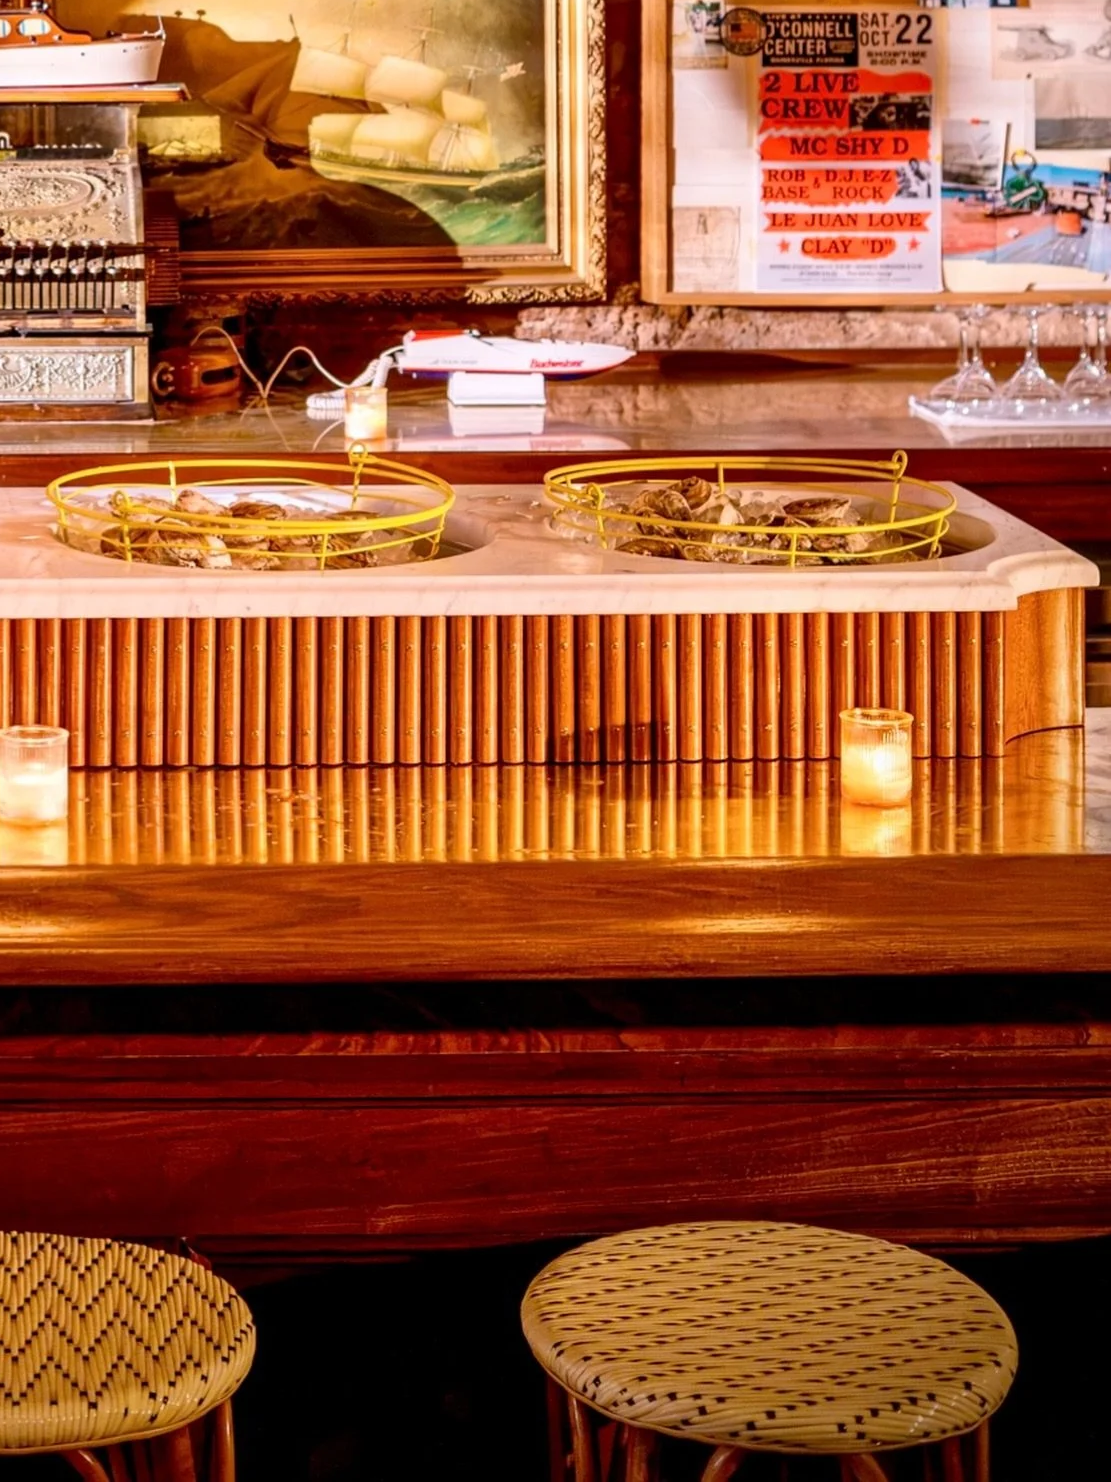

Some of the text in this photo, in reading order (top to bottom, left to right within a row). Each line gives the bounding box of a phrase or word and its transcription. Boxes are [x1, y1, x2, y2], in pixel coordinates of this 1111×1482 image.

[860, 13, 895, 28] SAT.
[895, 13, 933, 44] 22
[860, 31, 895, 46] OCT.
[764, 39, 827, 56] CENTER
[764, 73, 860, 93] 2 LIVE
[761, 97, 849, 119] CREW
[790, 137, 909, 155] MC SHY D
[767, 170, 806, 182] ROB
[762, 186, 884, 199] BASE ROCK
[771, 213, 922, 227] LE JUAN LOVE
[801, 239, 893, 254] CLAY "D"
